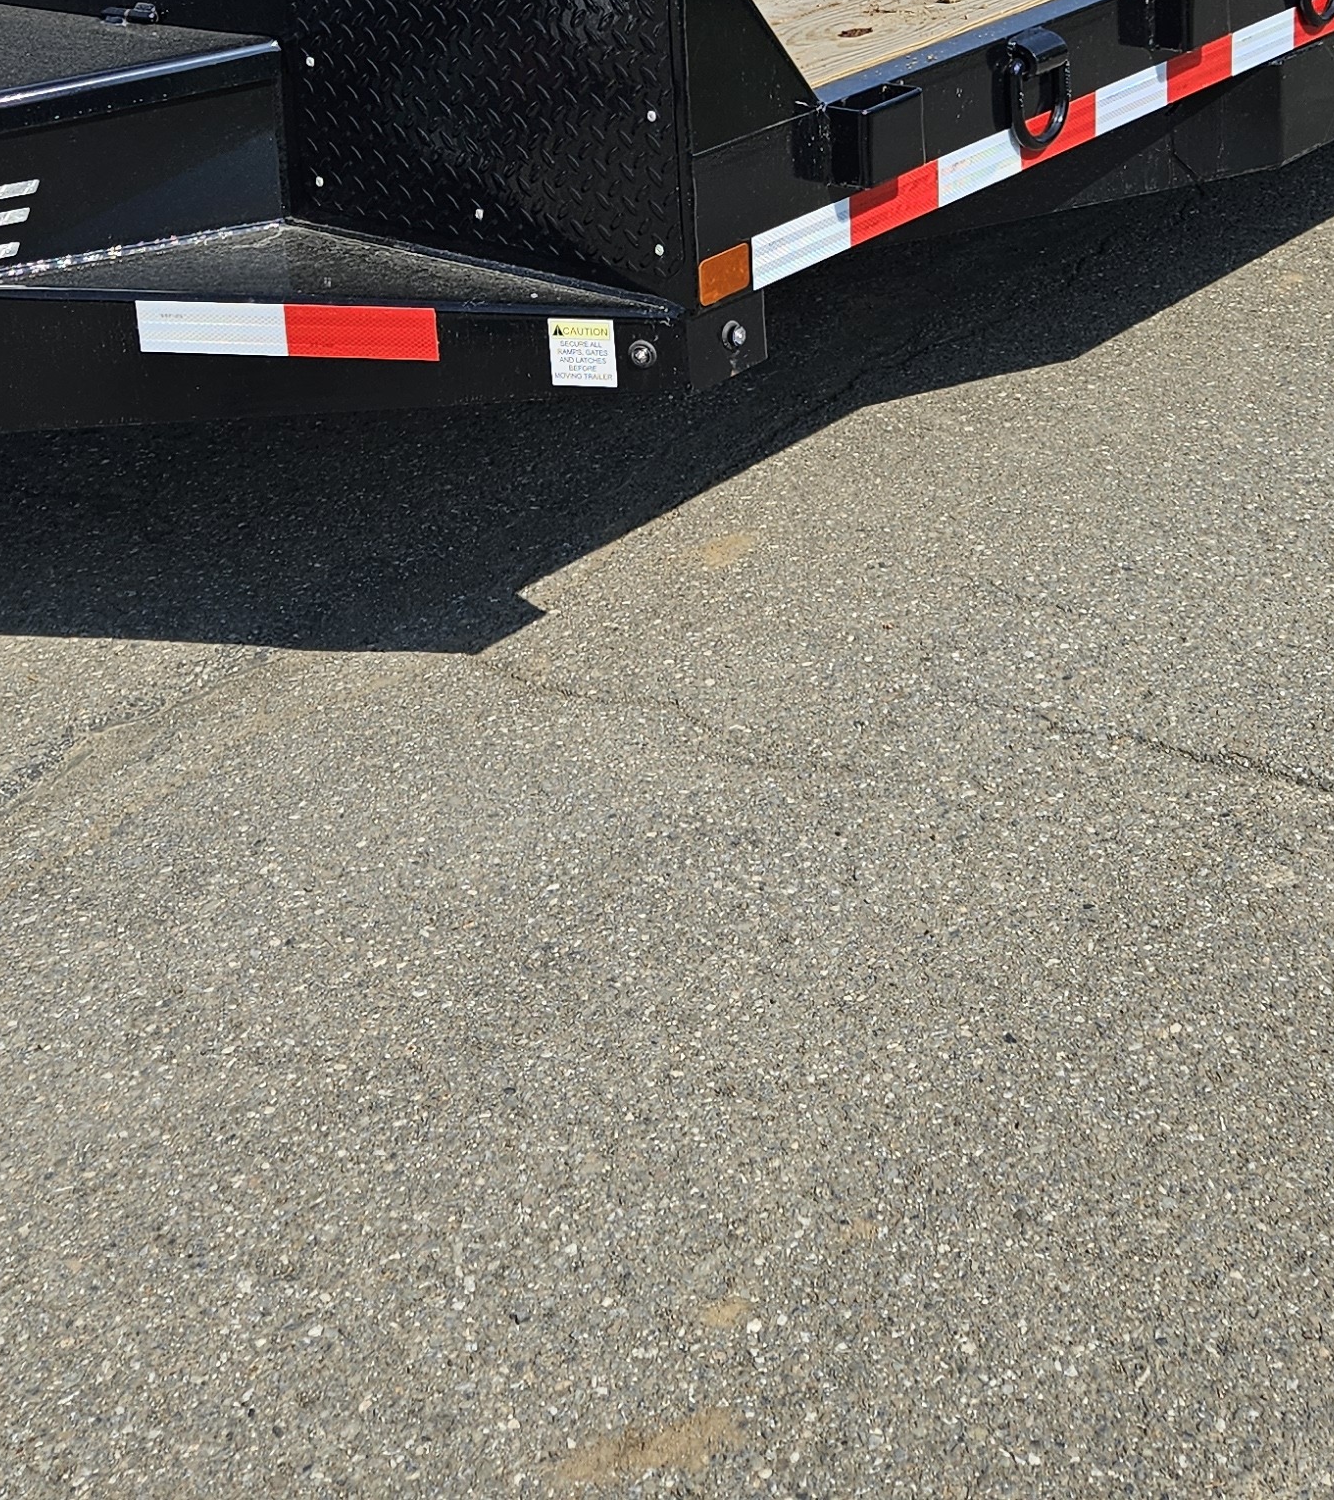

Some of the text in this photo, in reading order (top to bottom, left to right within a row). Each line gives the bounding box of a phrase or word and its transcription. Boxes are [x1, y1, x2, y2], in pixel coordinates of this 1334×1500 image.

[563, 326, 608, 337] CAUTION
[560, 340, 589, 348] SECURE
[585, 349, 608, 357] GATES
[559, 356, 607, 365] AND LATCHES
[554, 372, 613, 381] MOVING TRAILER
